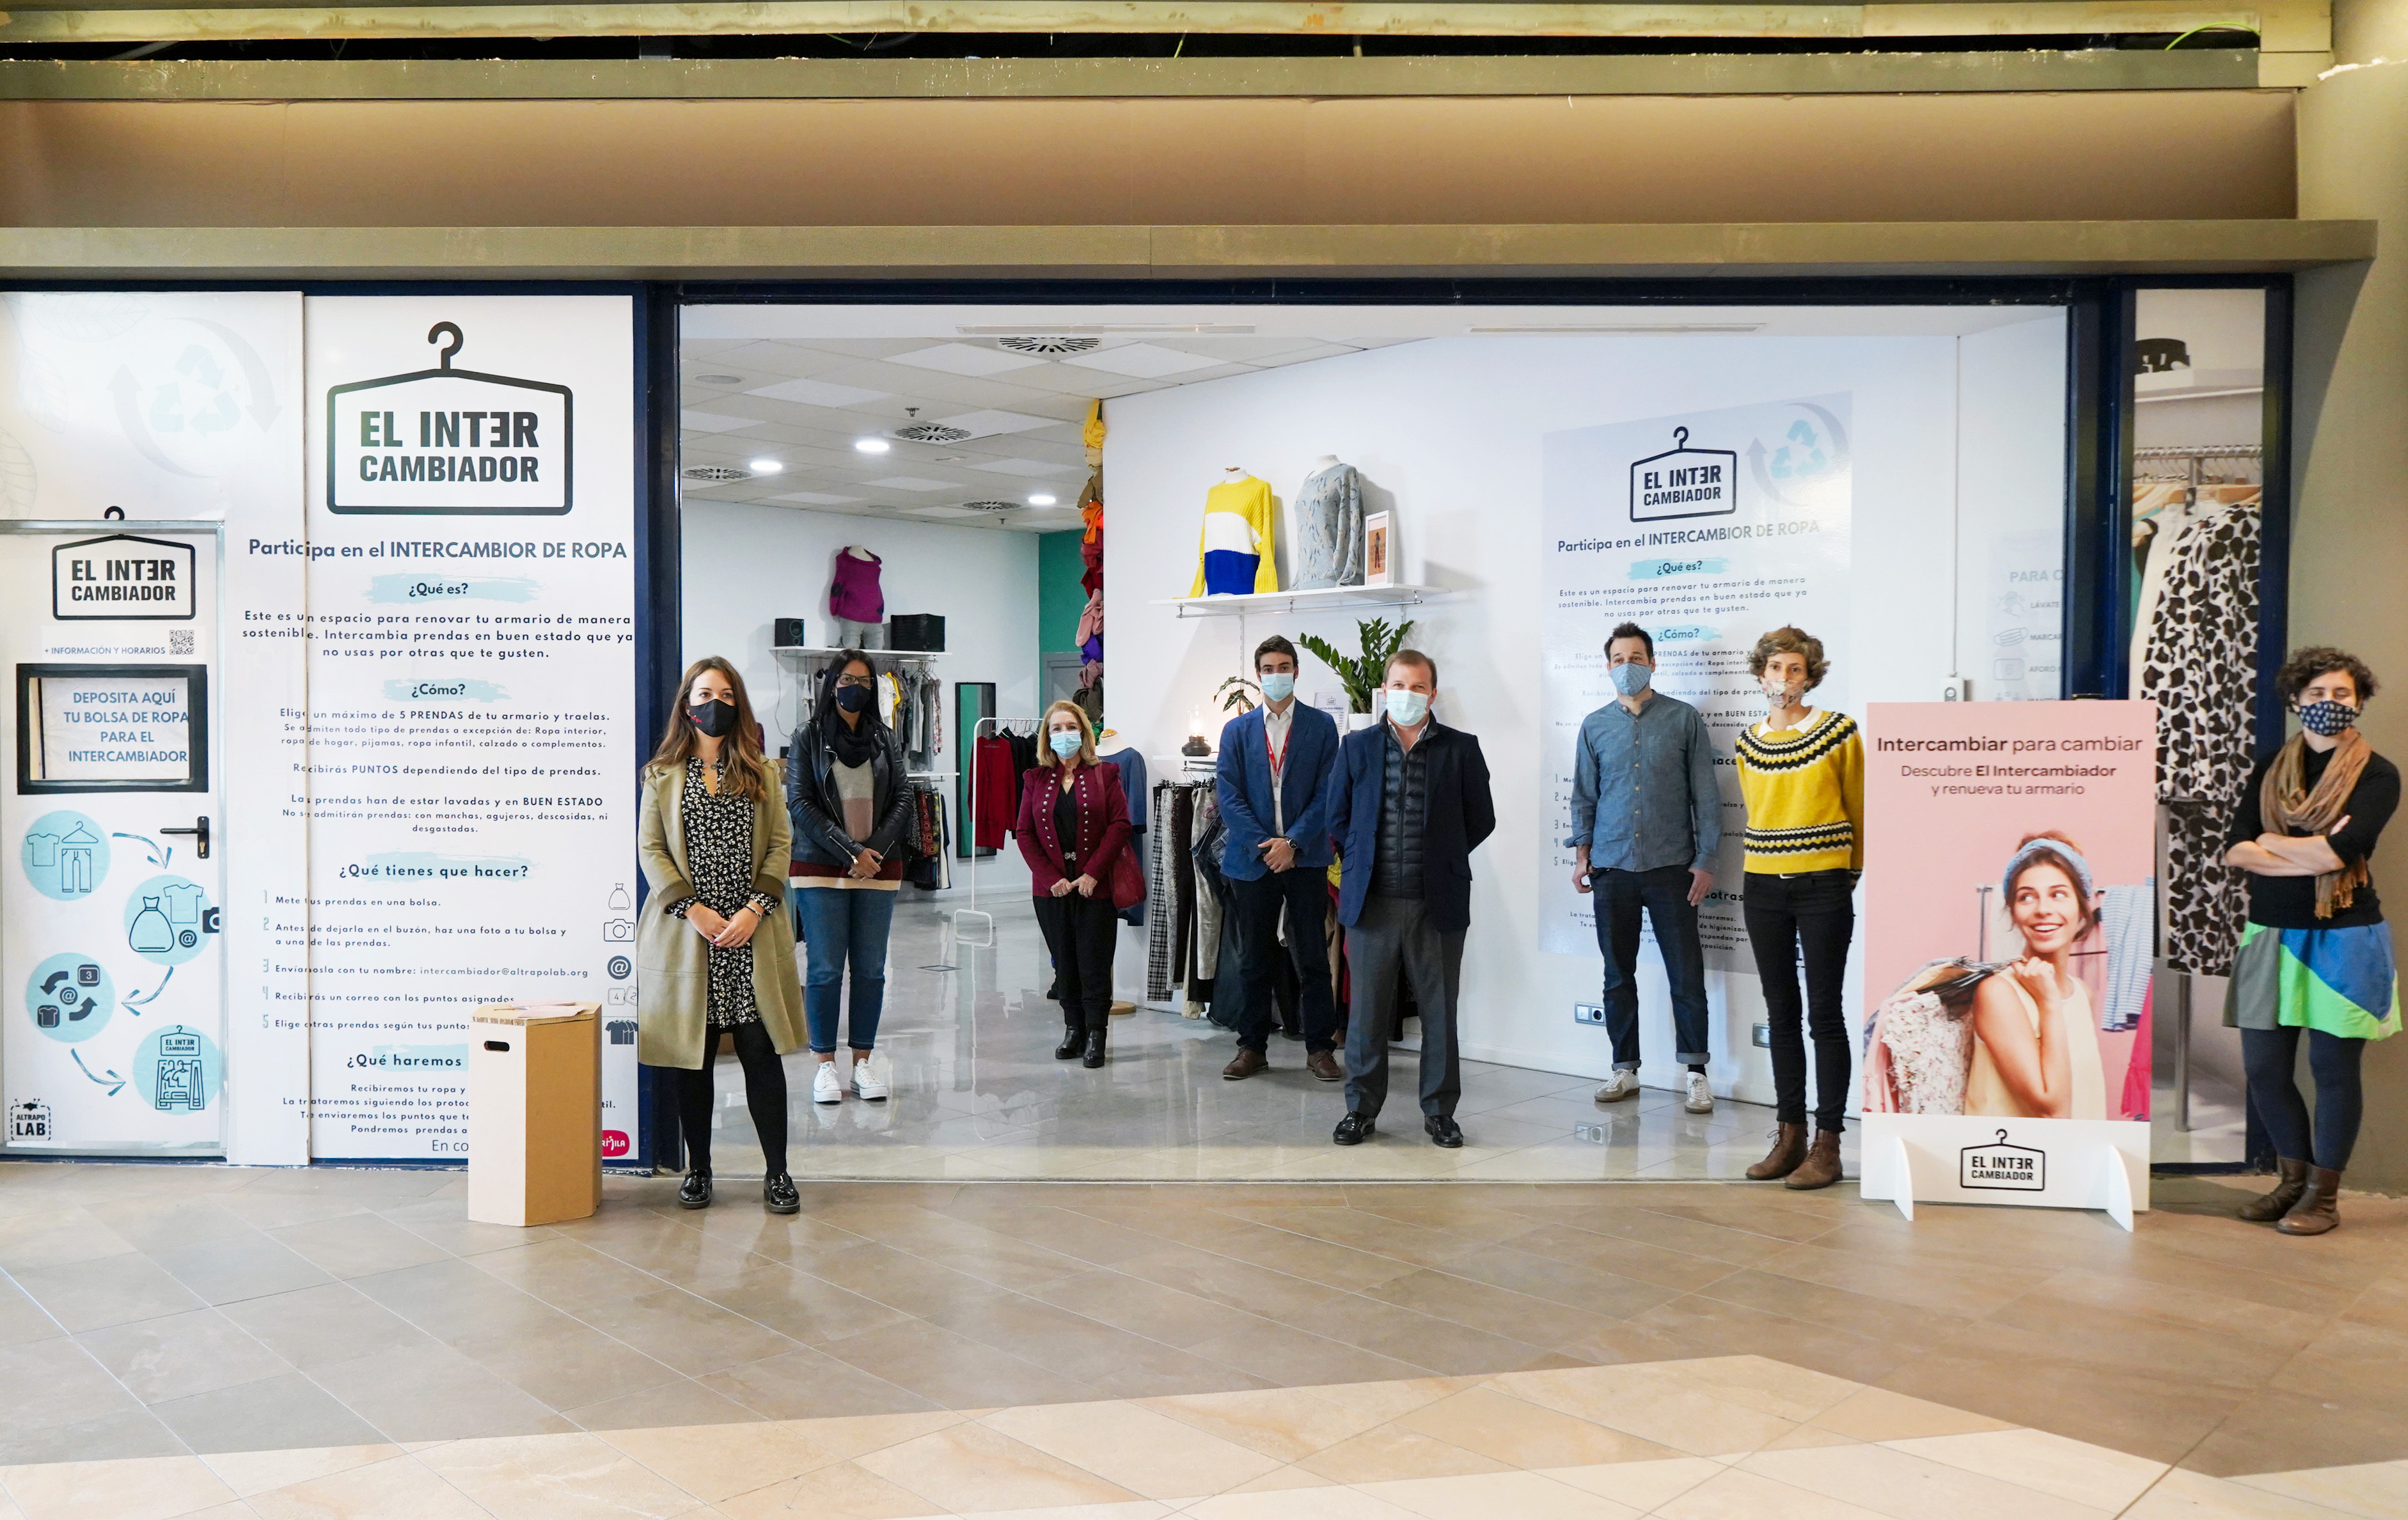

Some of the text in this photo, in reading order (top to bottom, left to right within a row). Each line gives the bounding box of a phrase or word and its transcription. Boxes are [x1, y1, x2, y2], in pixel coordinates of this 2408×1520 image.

[360, 410, 404, 448] EL
[359, 454, 540, 483] CAMBIADOR
[1644, 471, 1662, 490] EL
[1644, 486, 1721, 506] CAMBIADOR
[1558, 521, 1820, 553] Participa en el INTERCAMBIOR DE ROPA
[249, 538, 627, 561] Participa en el INTERCAMBIOR DE ROPA
[72, 560, 97, 581] EL
[1656, 560, 1703, 576] ¿Qué es?
[72, 585, 176, 601] CAMBIADOR
[409, 582, 469, 597] ¿Qué es?
[245, 610, 271, 620] Este
[297, 614, 314, 622] un
[320, 615, 372, 625] espacio
[377, 616, 409, 625] para
[476, 615, 489, 623] tu
[494, 614, 551, 624] armario
[556, 613, 572, 624] de
[325, 629, 407, 640] Intercambia
[414, 630, 469, 643] prendas
[496, 630, 529, 641] buen
[535, 631, 581, 641] estado
[586, 634, 611, 644] que
[617, 634, 633, 644] ya
[1658, 628, 1699, 642] ¿Cómo?
[51, 645, 111, 655] INFORMACIÓN
[380, 650, 403, 659] por
[409, 648, 445, 657] otras
[450, 650, 475, 660] que
[480, 648, 492, 657] te
[498, 649, 549, 661] gusten.
[73, 689, 176, 706] DEPOSITA AQUÍ
[411, 683, 466, 698] ¿Cómo?
[63, 711, 188, 723] TU BOLSA DE ROPA
[332, 710, 377, 719] máximo
[381, 710, 395, 719] de
[400, 710, 405, 719] 5
[411, 710, 463, 719] PRENDAS
[468, 710, 482, 720] de
[501, 712, 549, 720] armario
[553, 714, 560, 723] y
[564, 712, 610, 721] traelas.
[100, 731, 155, 742] PARA EL
[1878, 735, 2143, 755] Intercambiar para cambiar
[68, 750, 188, 762] INTERCAMBIADOR
[294, 763, 601, 778] Recibirás PUNTOS dependiendo del tipo de prendas.
[1901, 764, 2117, 777] Descubre El Intercambiador
[1931, 783, 2085, 797] y renueva tu armario
[315, 795, 362, 806] prendas
[366, 795, 388, 804] han
[392, 795, 405, 804] de
[445, 796, 490, 806] lavadas
[523, 797, 553, 806] BUEN
[558, 797, 602, 806] ESTADO
[412, 824, 478, 834] desgastadas.
[339, 864, 528, 879] ¿Qué tienes que hacer?
[373, 966, 416, 975] nombre:
[347, 1054, 461, 1069] ¿Qué haremos
[16, 1122, 46, 1136] LAB
[1972, 1156, 1987, 1168] EL
[1971, 1170, 2033, 1180] CAMBIADOR
